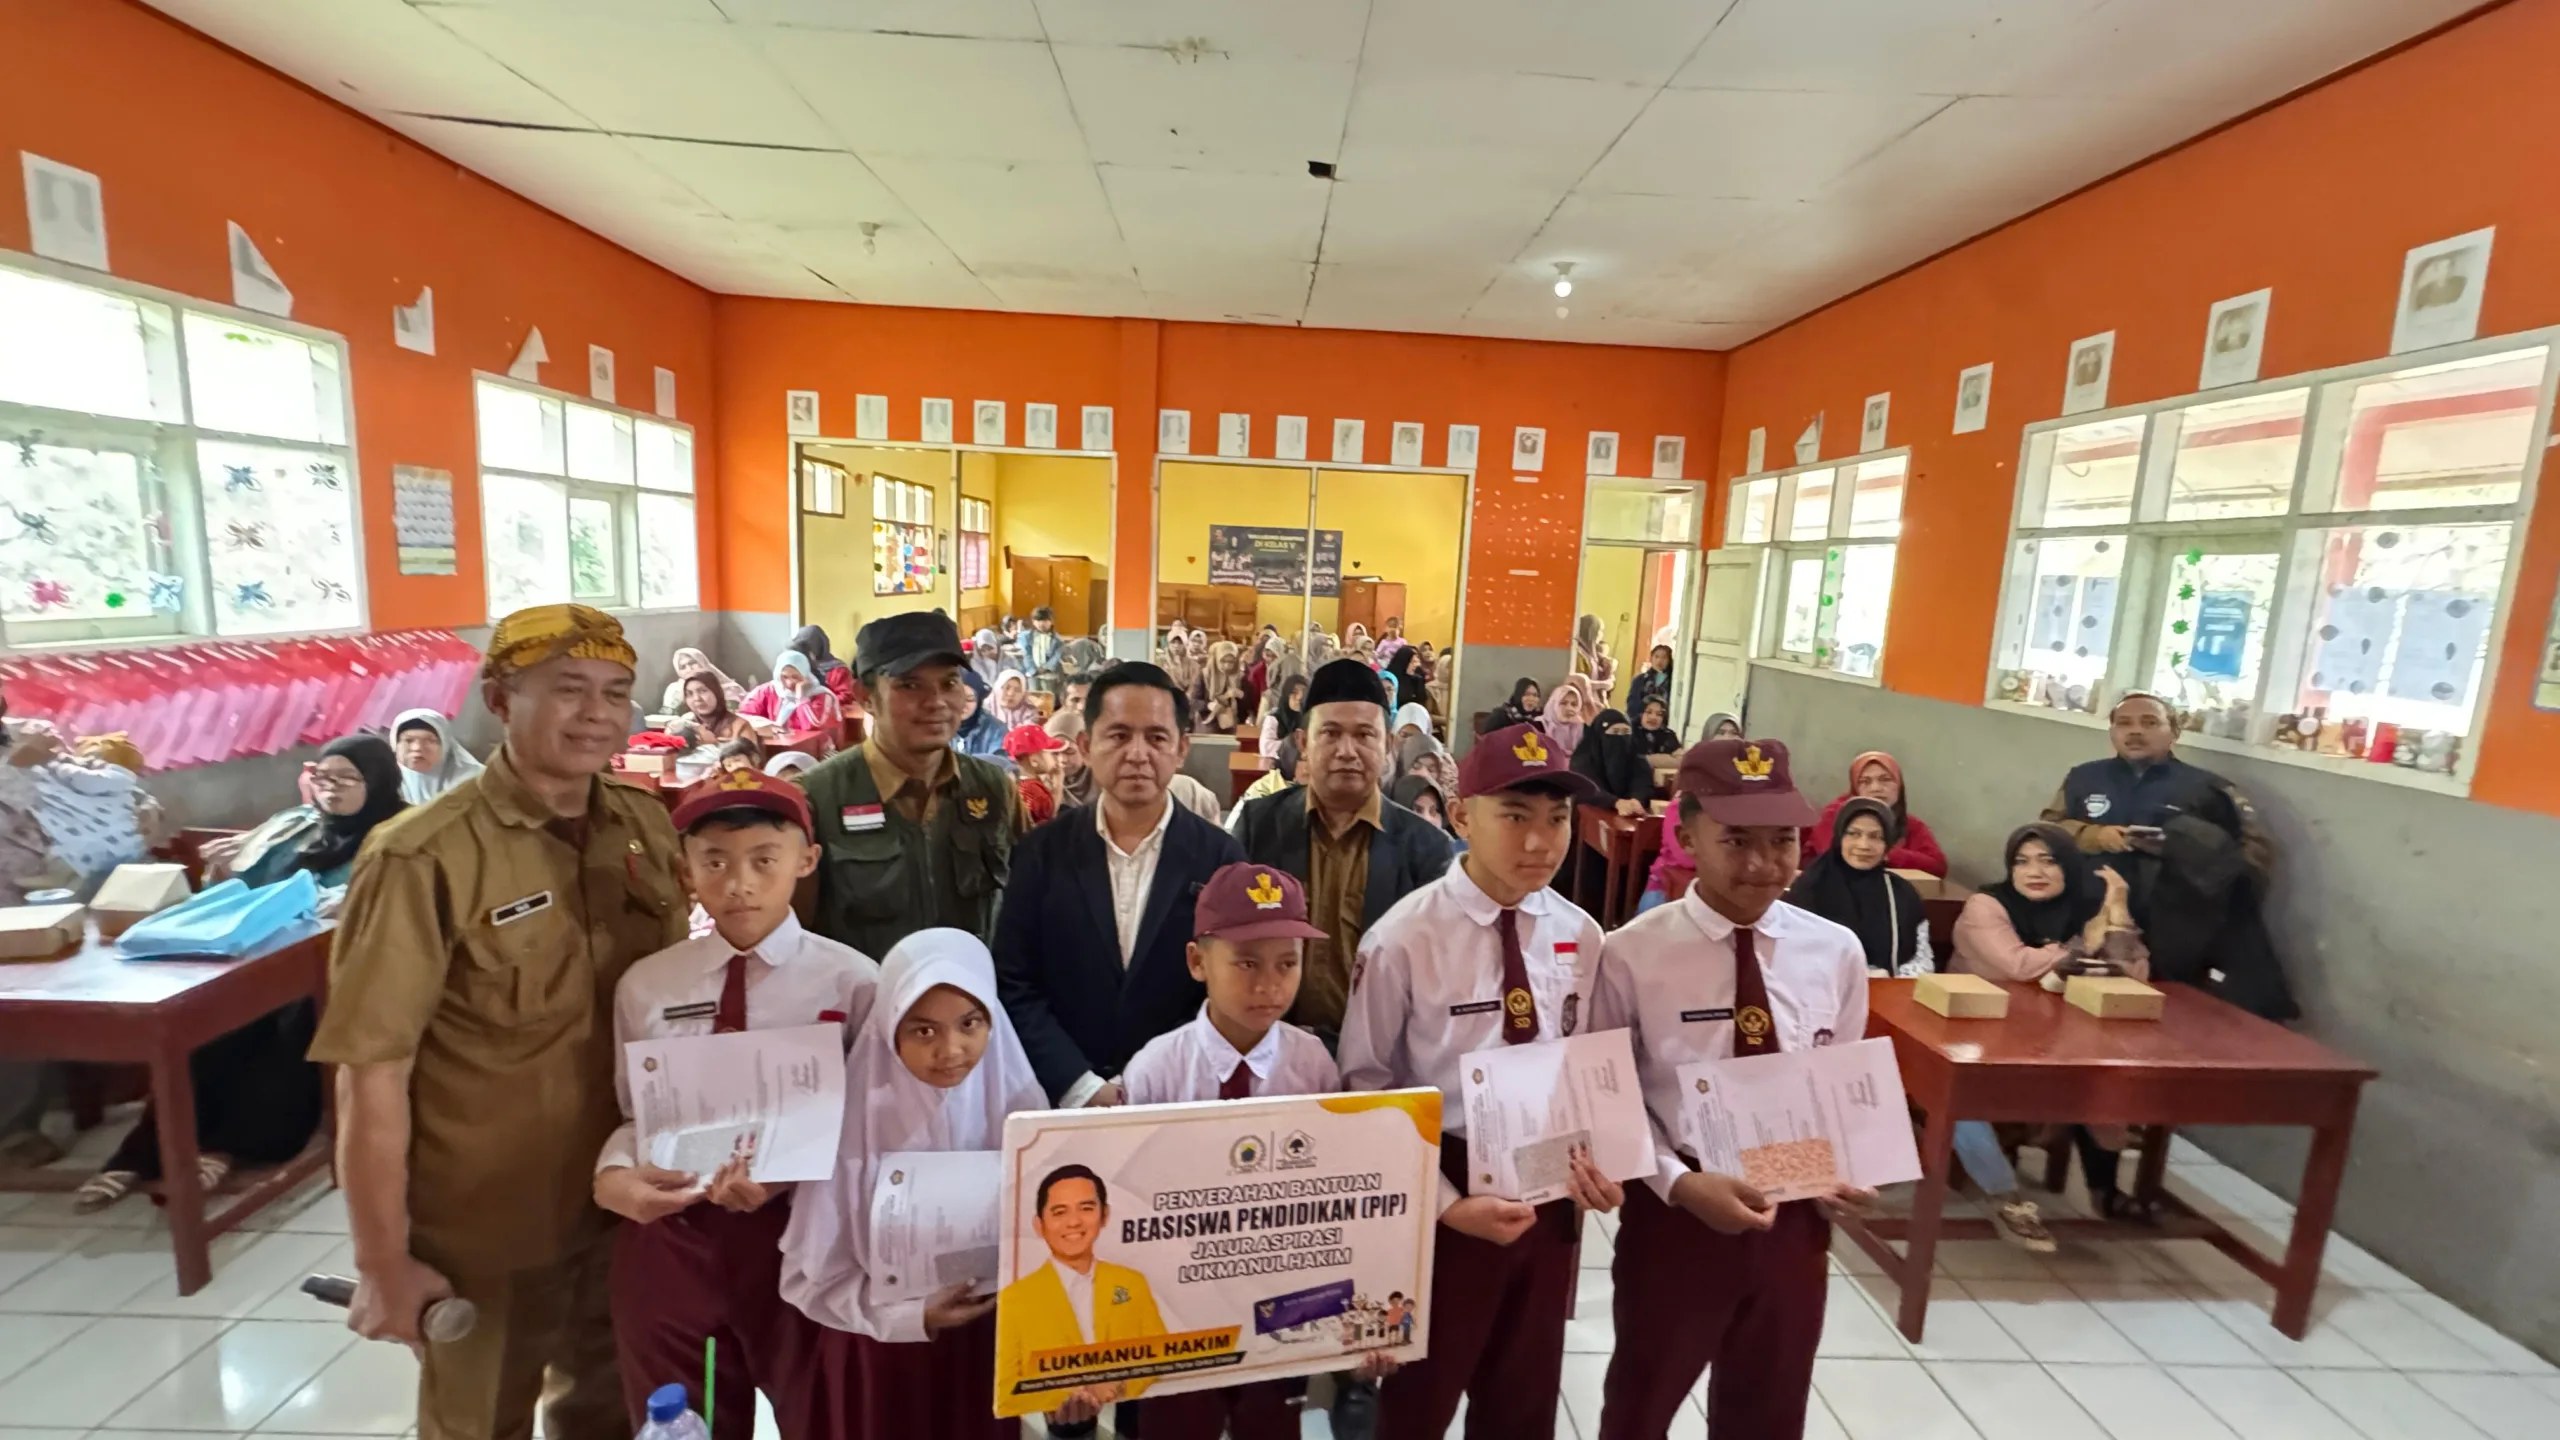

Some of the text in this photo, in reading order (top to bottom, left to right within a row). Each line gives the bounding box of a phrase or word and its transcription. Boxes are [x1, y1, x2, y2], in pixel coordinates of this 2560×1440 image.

[1153, 1173, 1382, 1211] PENYERAHAN BANTUAN
[1121, 1193, 1408, 1243] BEASISWA PENDIDIKAN (PIP)
[1190, 1228, 1343, 1260] JALUR ASPIRASI
[1178, 1248, 1352, 1284] LUKMANUL HAKIM
[1038, 1344, 1157, 1372] LUKMANUL
[1164, 1334, 1230, 1356] HAKIM
